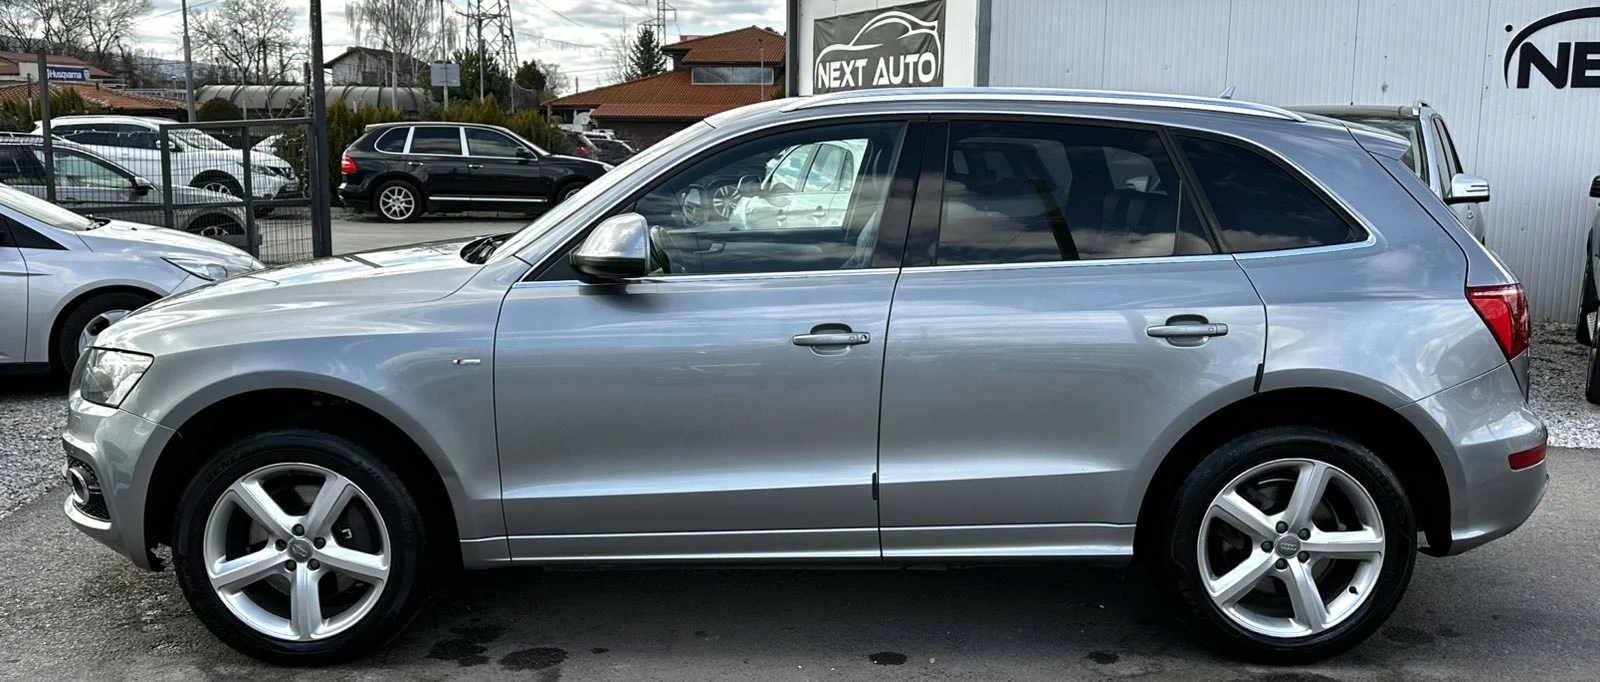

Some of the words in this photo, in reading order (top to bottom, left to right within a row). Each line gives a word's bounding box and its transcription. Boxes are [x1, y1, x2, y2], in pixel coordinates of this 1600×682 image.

[49, 69, 82, 80] Husqvarna
[818, 58, 868, 89] NEXT
[872, 52, 936, 86] AUTO
